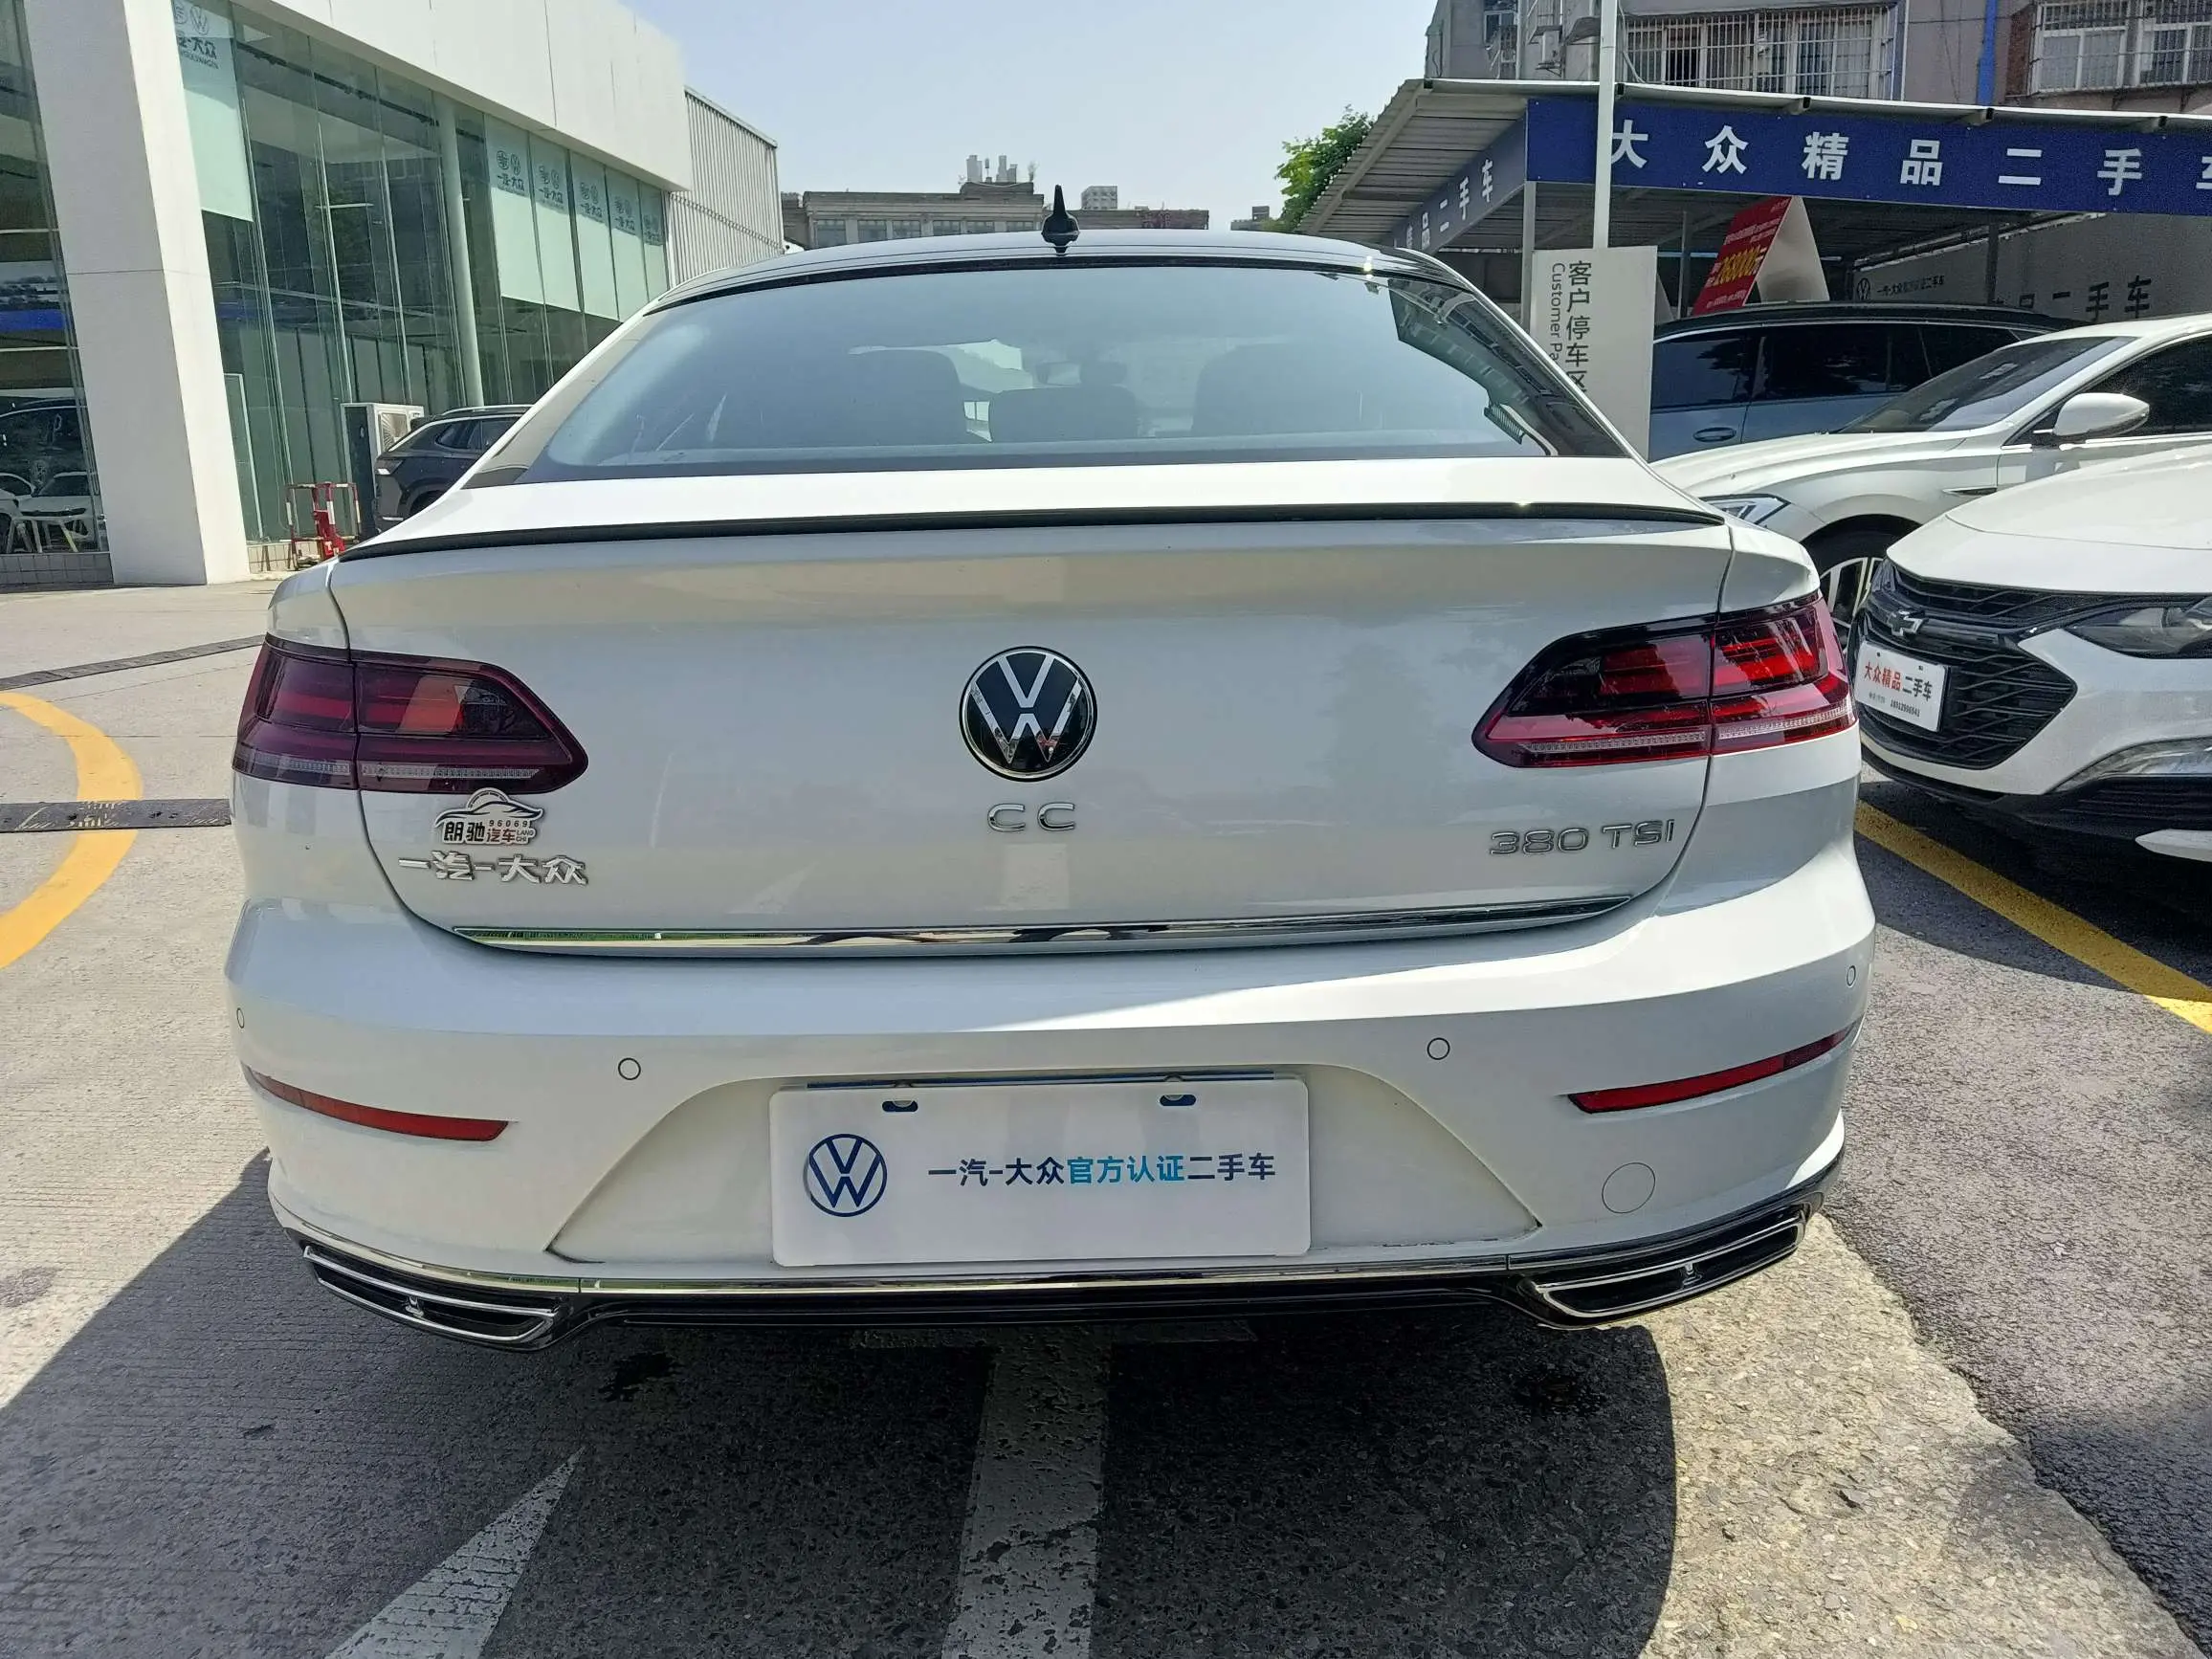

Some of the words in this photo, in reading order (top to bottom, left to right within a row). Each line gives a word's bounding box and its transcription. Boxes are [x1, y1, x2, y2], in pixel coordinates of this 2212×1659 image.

[1550, 262, 1565, 338] Customer
[1565, 260, 1592, 393] 客户停车区
[1549, 343, 1563, 362] Pa
[1864, 660, 1933, 701] 大众精品二手车
[987, 802, 1076, 832] CC
[1490, 830, 1589, 855] 380
[1602, 819, 1675, 849] TSI
[398, 850, 588, 886] 一汽-大众
[927, 1152, 1276, 1187] 一汽-大众官方认证二手车
